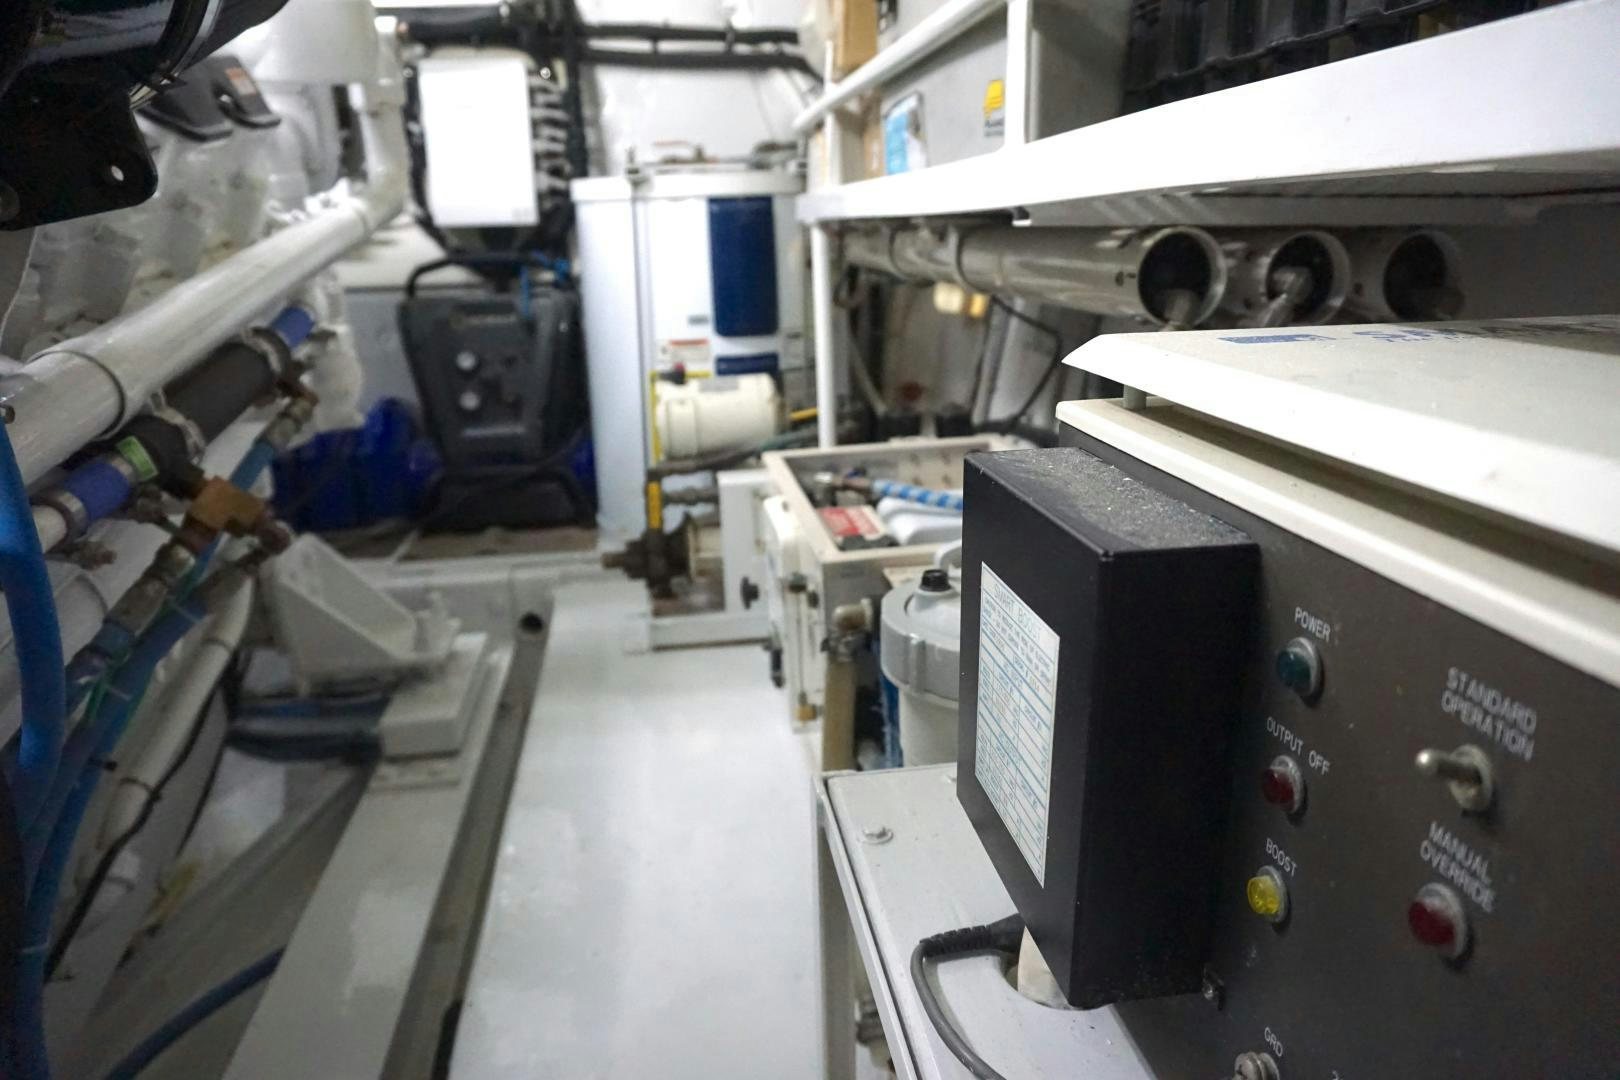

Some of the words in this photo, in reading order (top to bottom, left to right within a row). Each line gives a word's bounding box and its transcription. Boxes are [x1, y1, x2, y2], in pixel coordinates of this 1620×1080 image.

[1294, 606, 1331, 643] POWER
[1441, 690, 1535, 762] OPERATION
[1446, 667, 1537, 735] STANDARD
[1266, 716, 1303, 756] OUTPUT
[1308, 750, 1330, 776] OFF
[1266, 838, 1297, 877] BOOST
[1420, 840, 1495, 912] OVERRIDE
[1430, 821, 1492, 882] MANUAL
[1264, 1026, 1283, 1057] GRD
